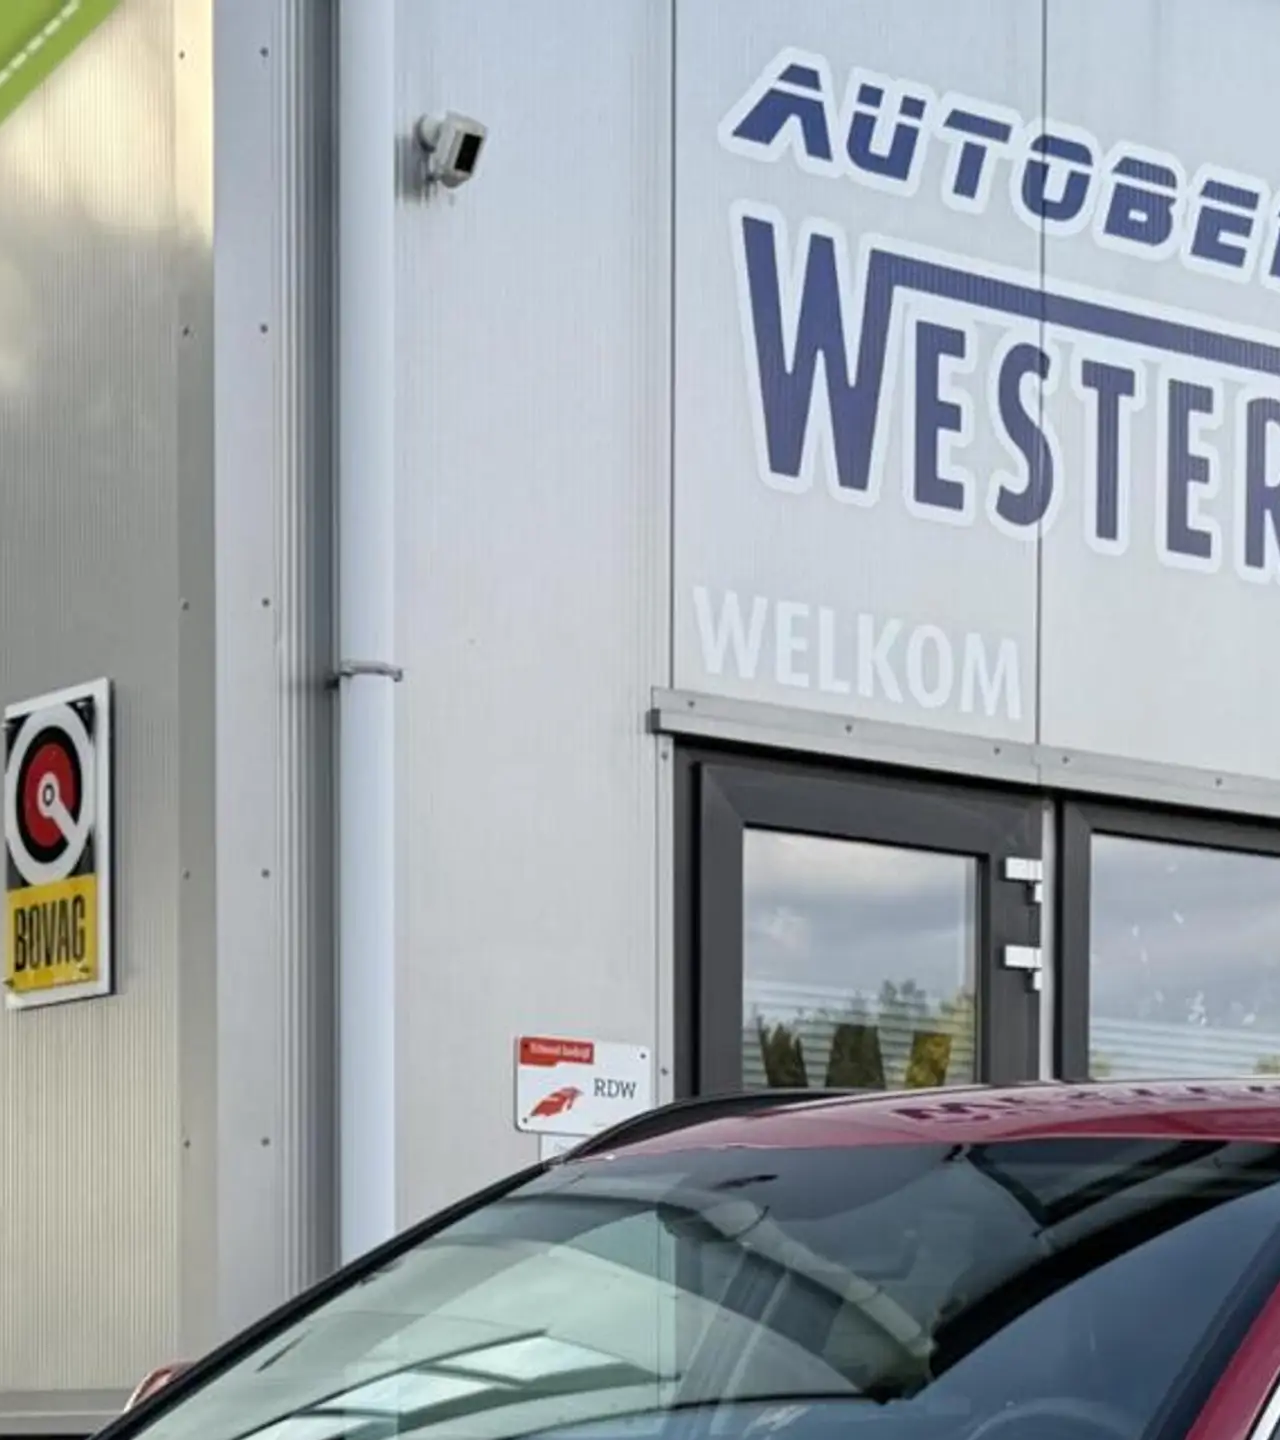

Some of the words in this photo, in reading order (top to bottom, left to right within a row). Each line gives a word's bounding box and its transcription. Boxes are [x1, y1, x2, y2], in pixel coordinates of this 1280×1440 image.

[693, 586, 1023, 722] WELKOM
[13, 894, 87, 972] BOVAG
[593, 1077, 637, 1099] RDW
